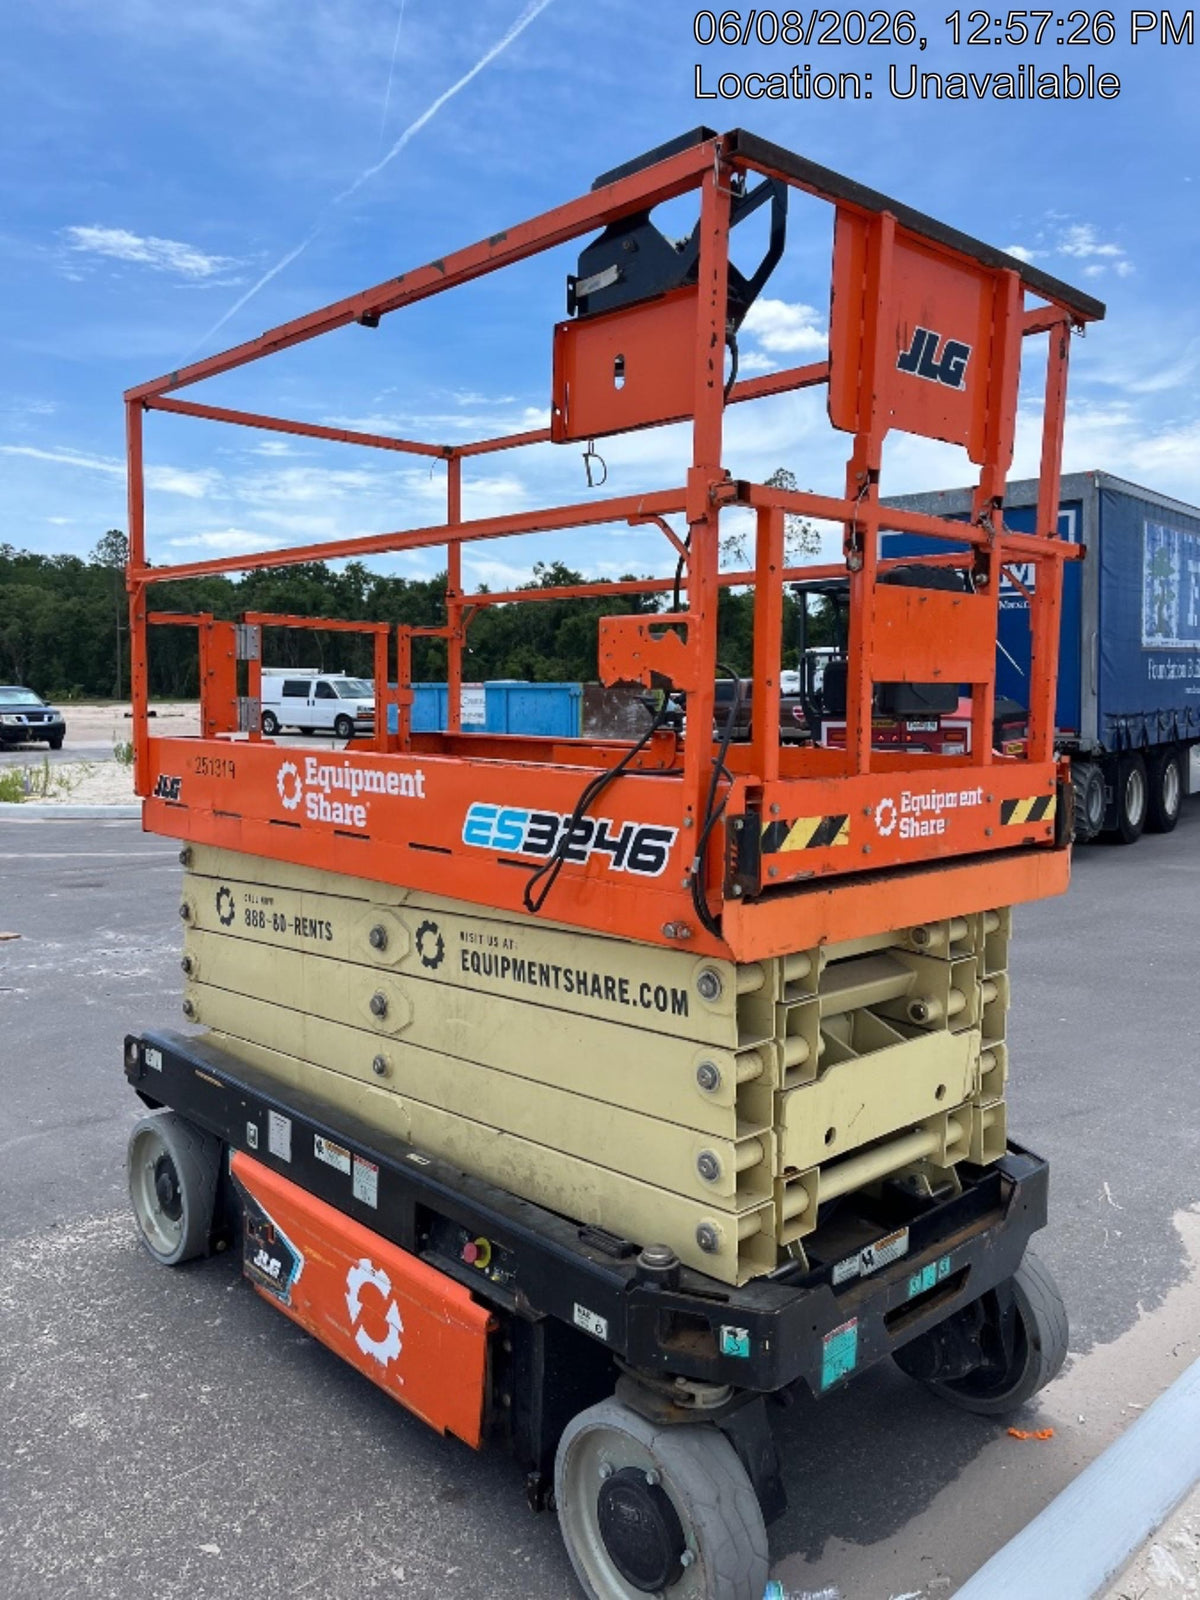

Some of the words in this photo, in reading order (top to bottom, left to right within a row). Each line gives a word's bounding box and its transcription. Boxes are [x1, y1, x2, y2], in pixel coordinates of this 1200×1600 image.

[896, 325, 972, 391] JLG
[304, 756, 426, 798] Equipment
[305, 792, 369, 828] Share
[901, 786, 983, 816] Equipment
[461, 802, 679, 877] ES3246
[899, 816, 946, 838] Share
[244, 908, 333, 941] 888-80-RENTS
[461, 949, 690, 1018] EQUIPMENTSHARE.COM
